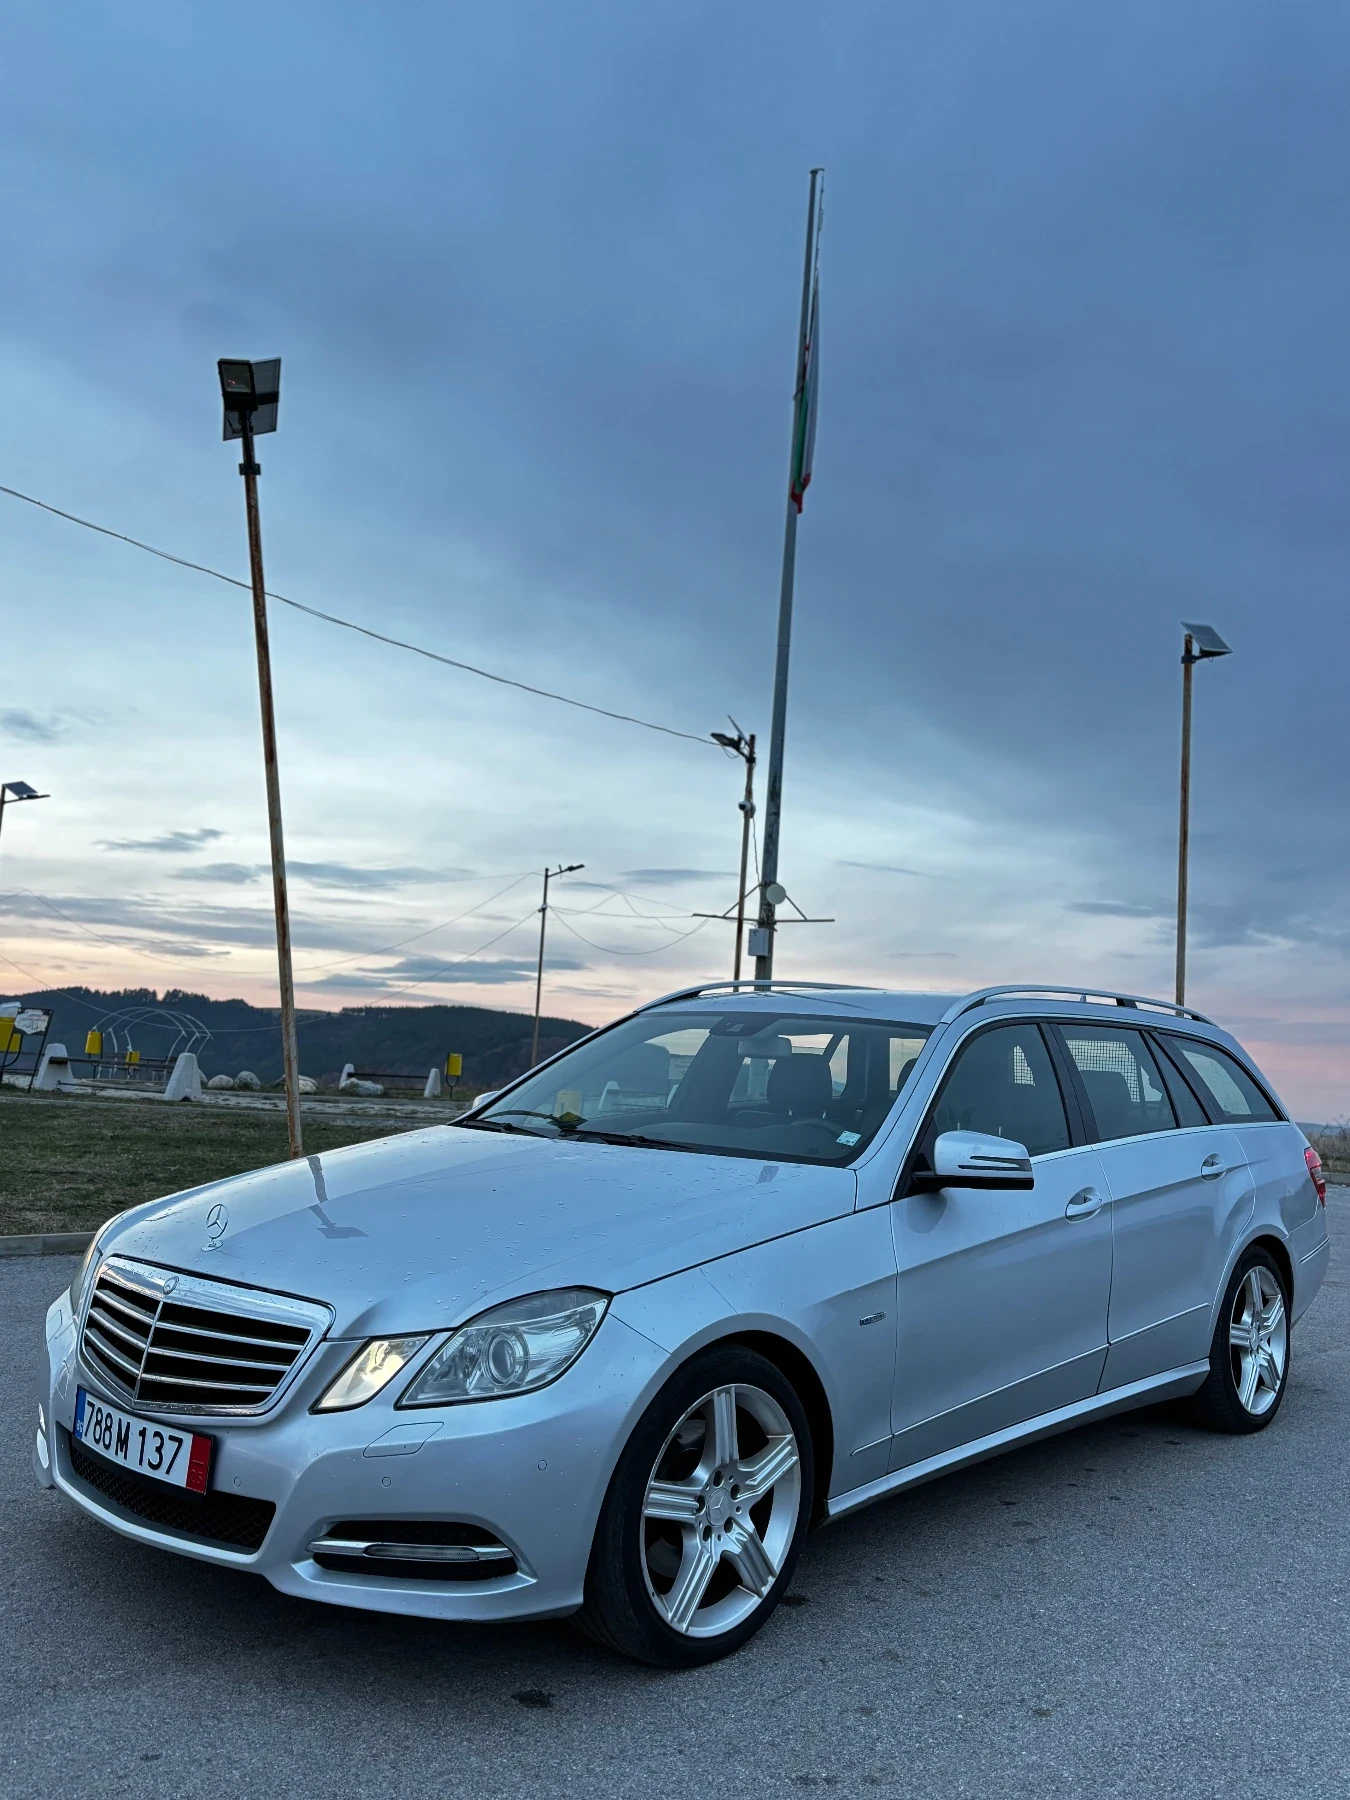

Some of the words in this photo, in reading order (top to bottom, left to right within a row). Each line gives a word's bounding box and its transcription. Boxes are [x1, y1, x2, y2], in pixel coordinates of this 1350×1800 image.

[84, 1400, 113, 1450] 788
[115, 1417, 130, 1460] M
[138, 1426, 183, 1475] 137
